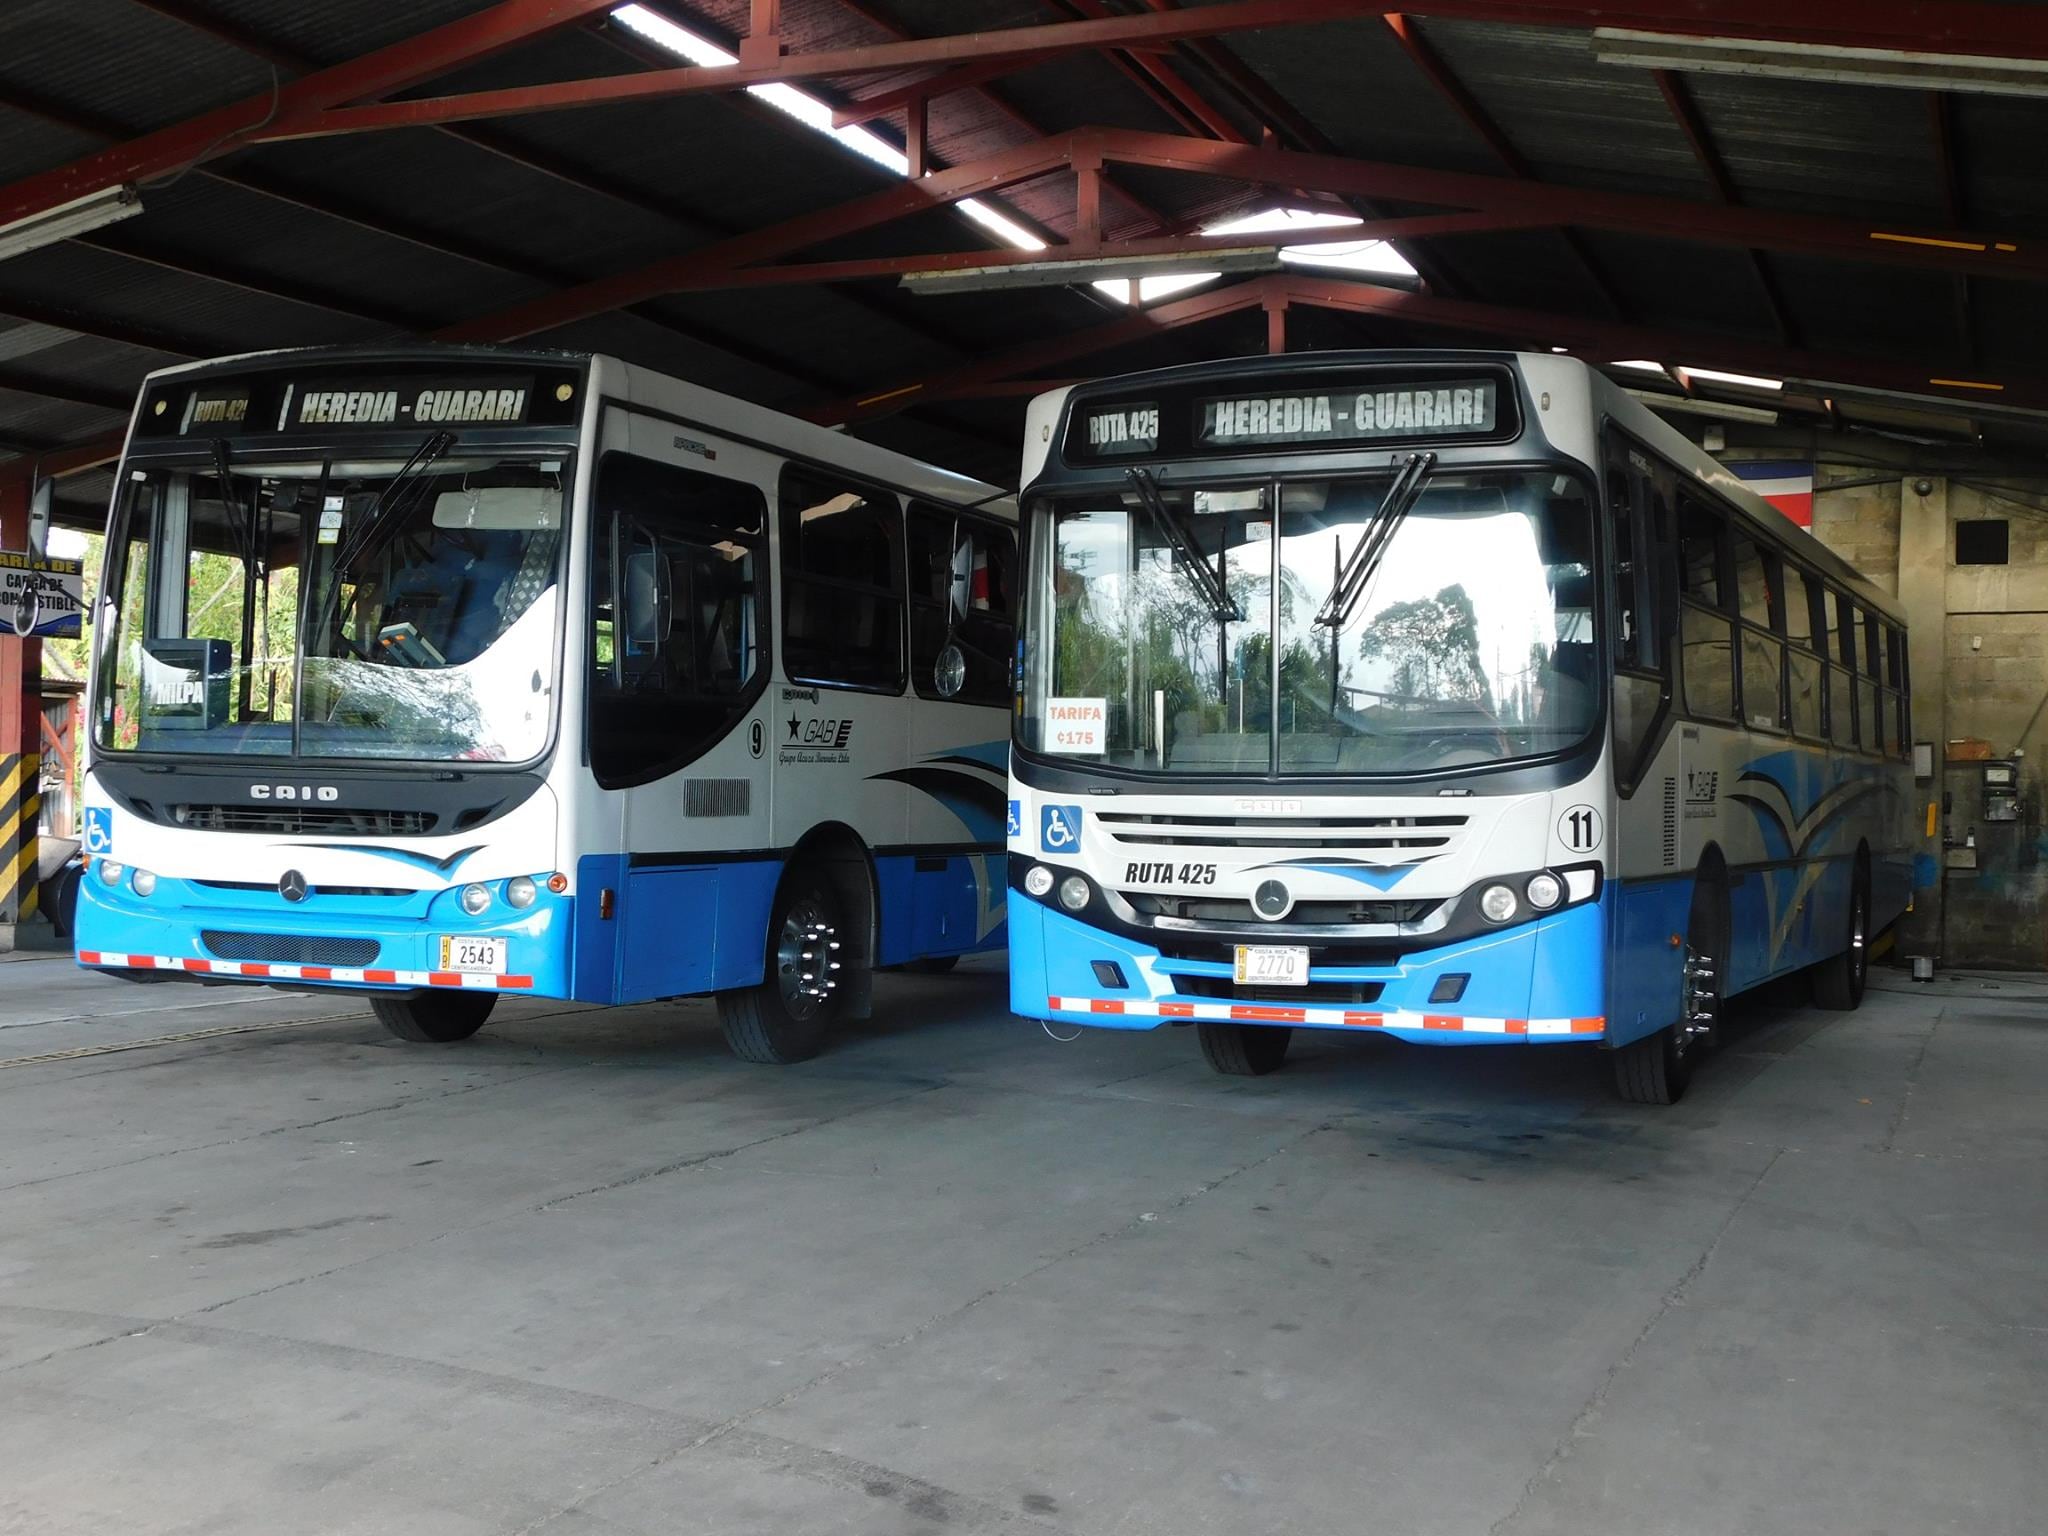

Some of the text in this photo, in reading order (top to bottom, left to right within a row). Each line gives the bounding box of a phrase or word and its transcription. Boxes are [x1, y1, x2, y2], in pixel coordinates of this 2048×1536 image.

[193, 400, 227, 423] RUTA
[299, 391, 398, 423] HEREDIA
[414, 390, 525, 422] GUARARI
[1214, 396, 1332, 436] HEREDIA
[1355, 388, 1484, 431] GUARARI
[1089, 409, 1159, 444] RUTA 425
[51, 561, 76, 573] DE
[0, 590, 77, 612] OMSTIBLE
[1049, 706, 1102, 720] TARIFA
[752, 722, 762, 754] 9
[250, 784, 339, 801] CAIO
[1568, 810, 1593, 848] 11
[1124, 862, 1218, 885] RUTA 425
[460, 945, 494, 965] 2543
[1257, 955, 1295, 975] 2770
